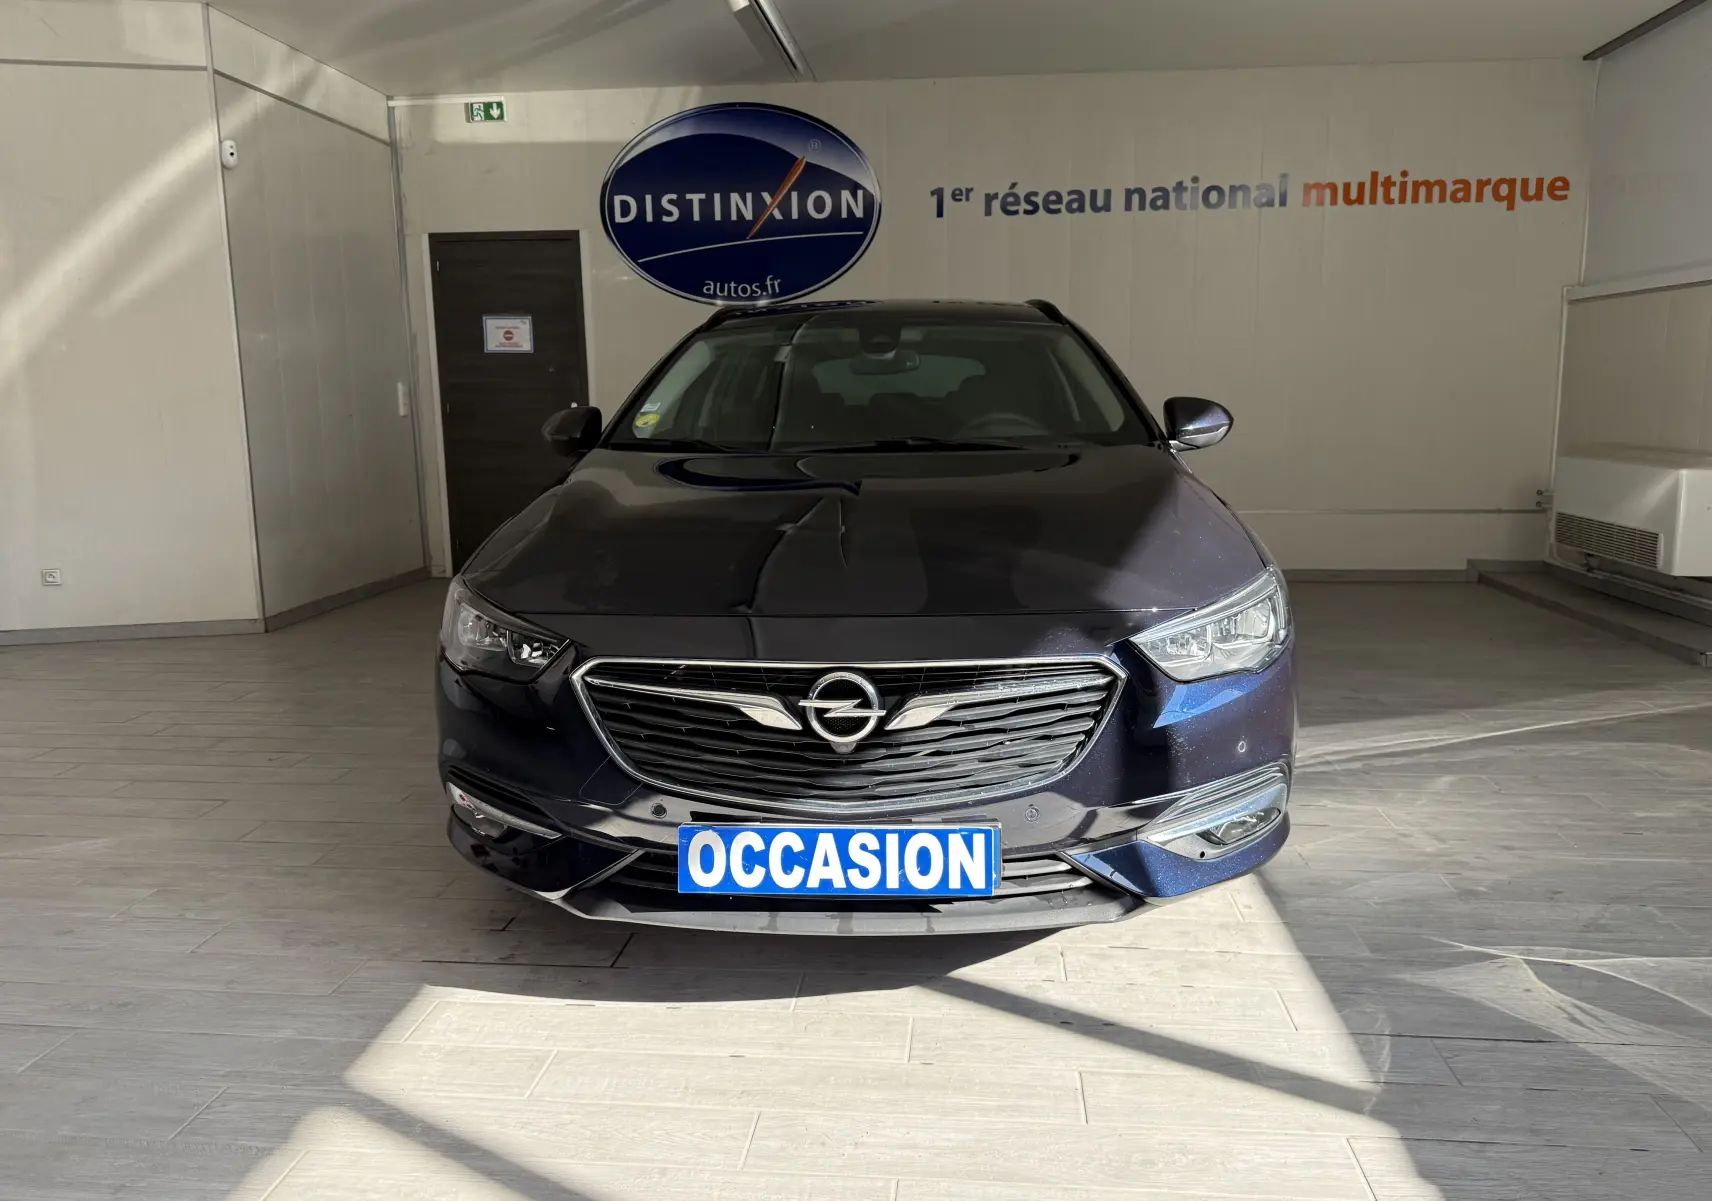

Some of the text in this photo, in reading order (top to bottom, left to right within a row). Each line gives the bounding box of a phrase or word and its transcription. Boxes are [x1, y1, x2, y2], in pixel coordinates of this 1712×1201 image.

[613, 189, 865, 224] DISTINXION
[930, 169, 1570, 218] 1er réseau national multimarque
[702, 275, 782, 298] autos.fr
[687, 830, 986, 890] OCCASION
